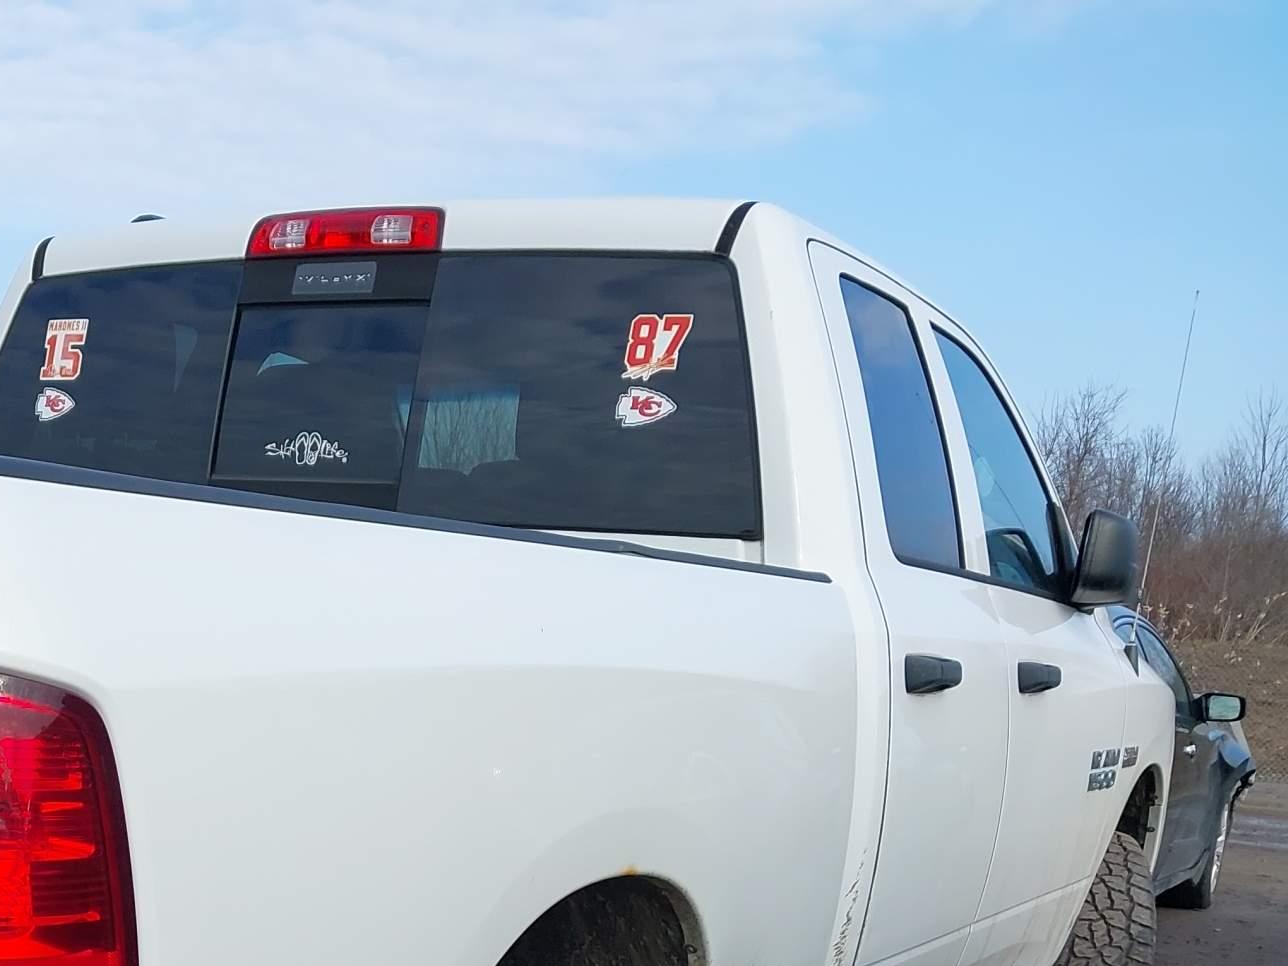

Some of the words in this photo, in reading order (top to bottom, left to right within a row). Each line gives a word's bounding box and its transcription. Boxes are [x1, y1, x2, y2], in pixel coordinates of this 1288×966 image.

[49, 320, 81, 331] MAHOMES
[626, 316, 692, 368] 87
[41, 333, 84, 378] 15
[45, 395, 66, 413] KC
[630, 396, 662, 417] KC
